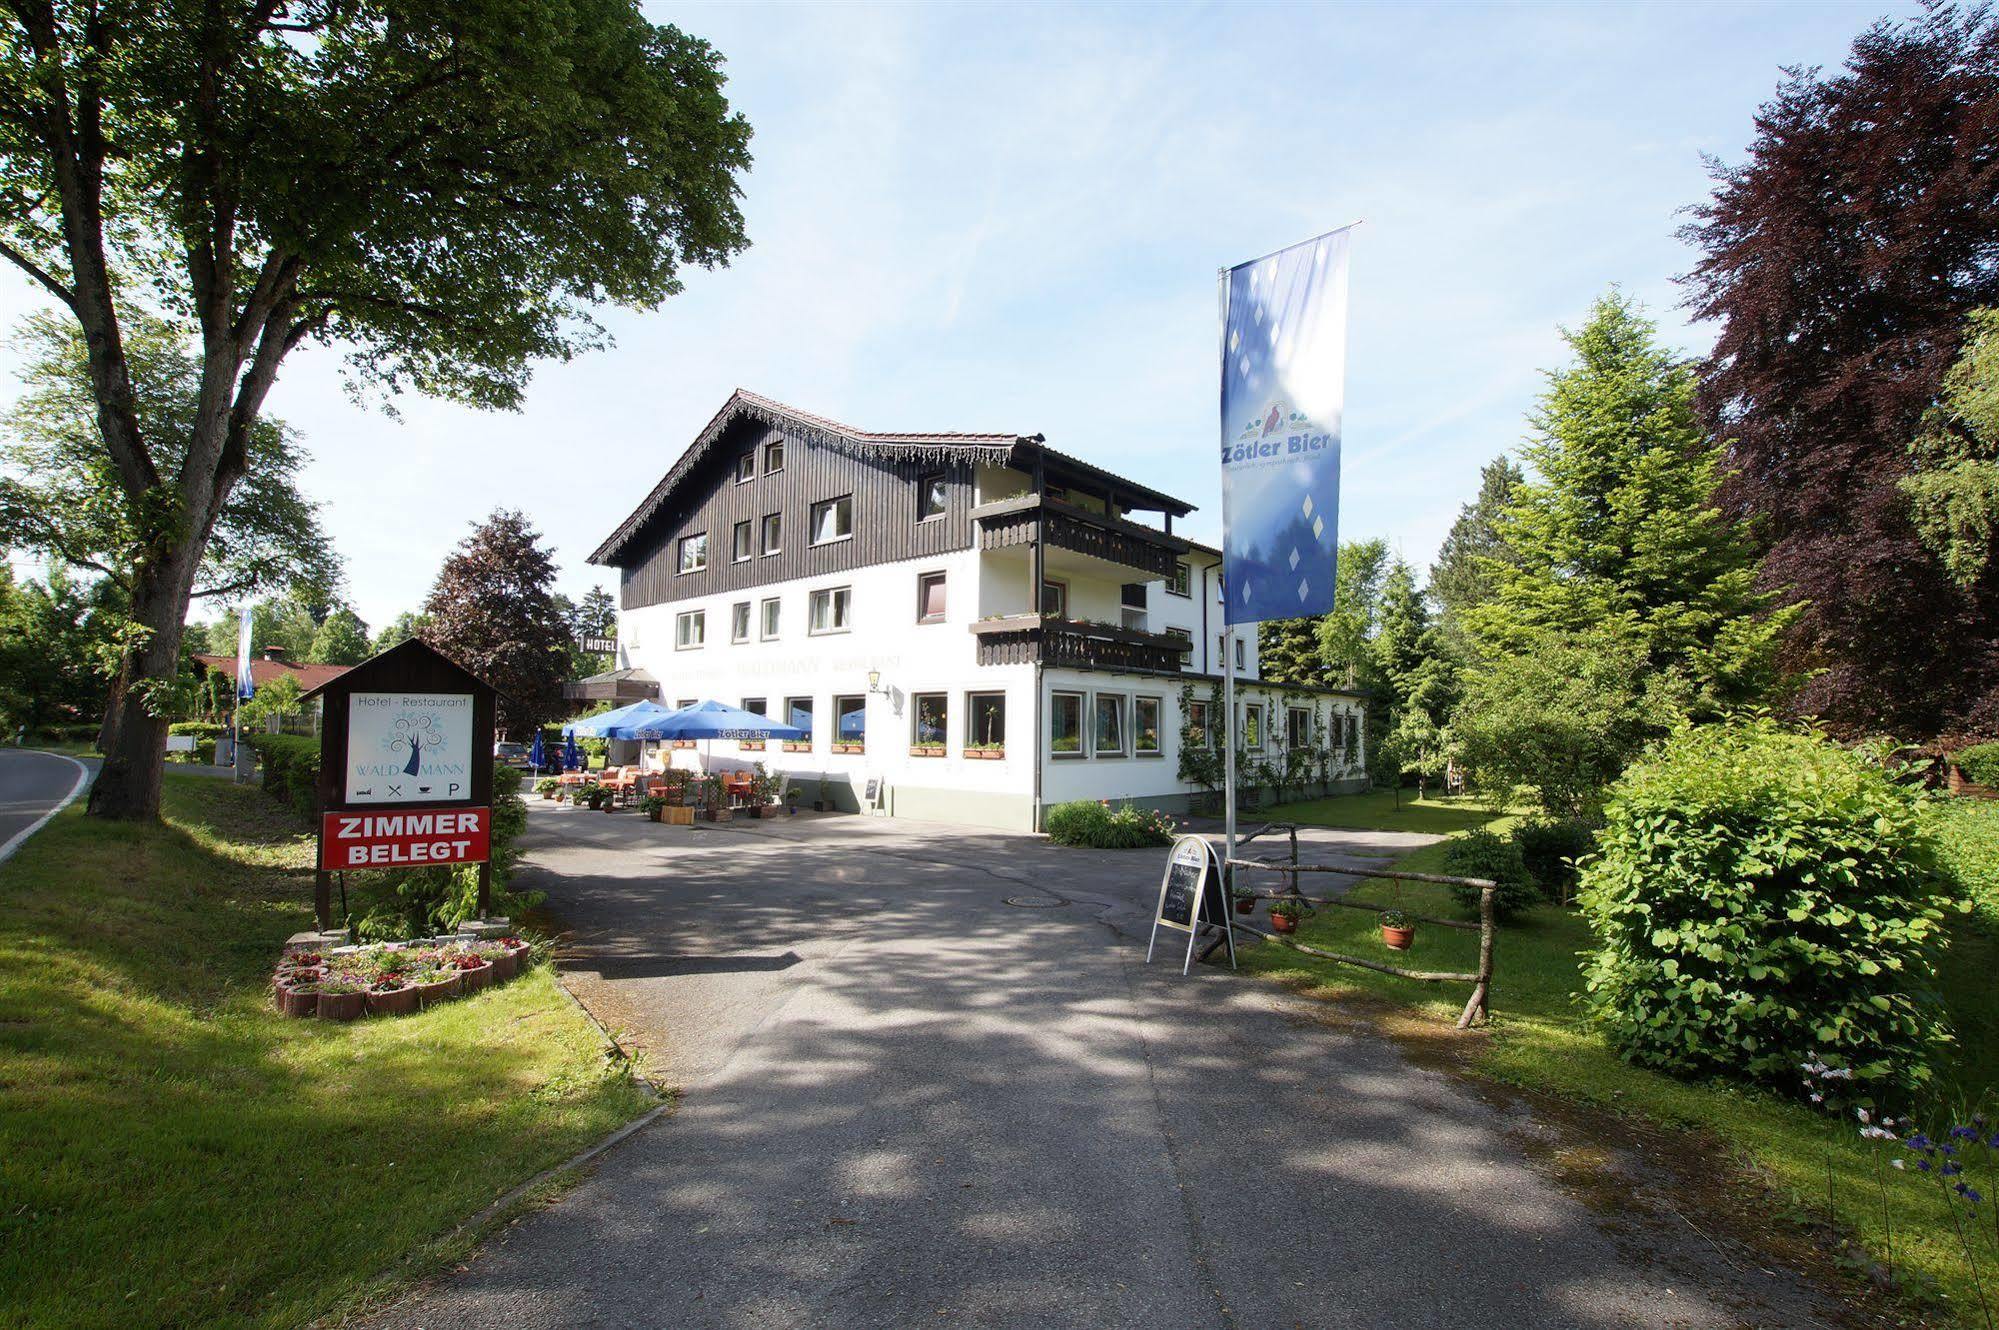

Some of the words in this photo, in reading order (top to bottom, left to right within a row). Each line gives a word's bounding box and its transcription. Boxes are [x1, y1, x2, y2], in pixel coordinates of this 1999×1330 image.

[1221, 441, 1281, 464] Zötler
[1288, 433, 1330, 454] Bier
[586, 639, 616, 651] HOTEL
[358, 697, 391, 707] Hotel
[402, 697, 466, 707] Restaurant
[356, 764, 400, 776] WALD
[421, 764, 464, 775] MANN
[449, 783, 459, 796] P
[338, 813, 480, 839] ZIMMER
[348, 841, 471, 865] BELEGT
